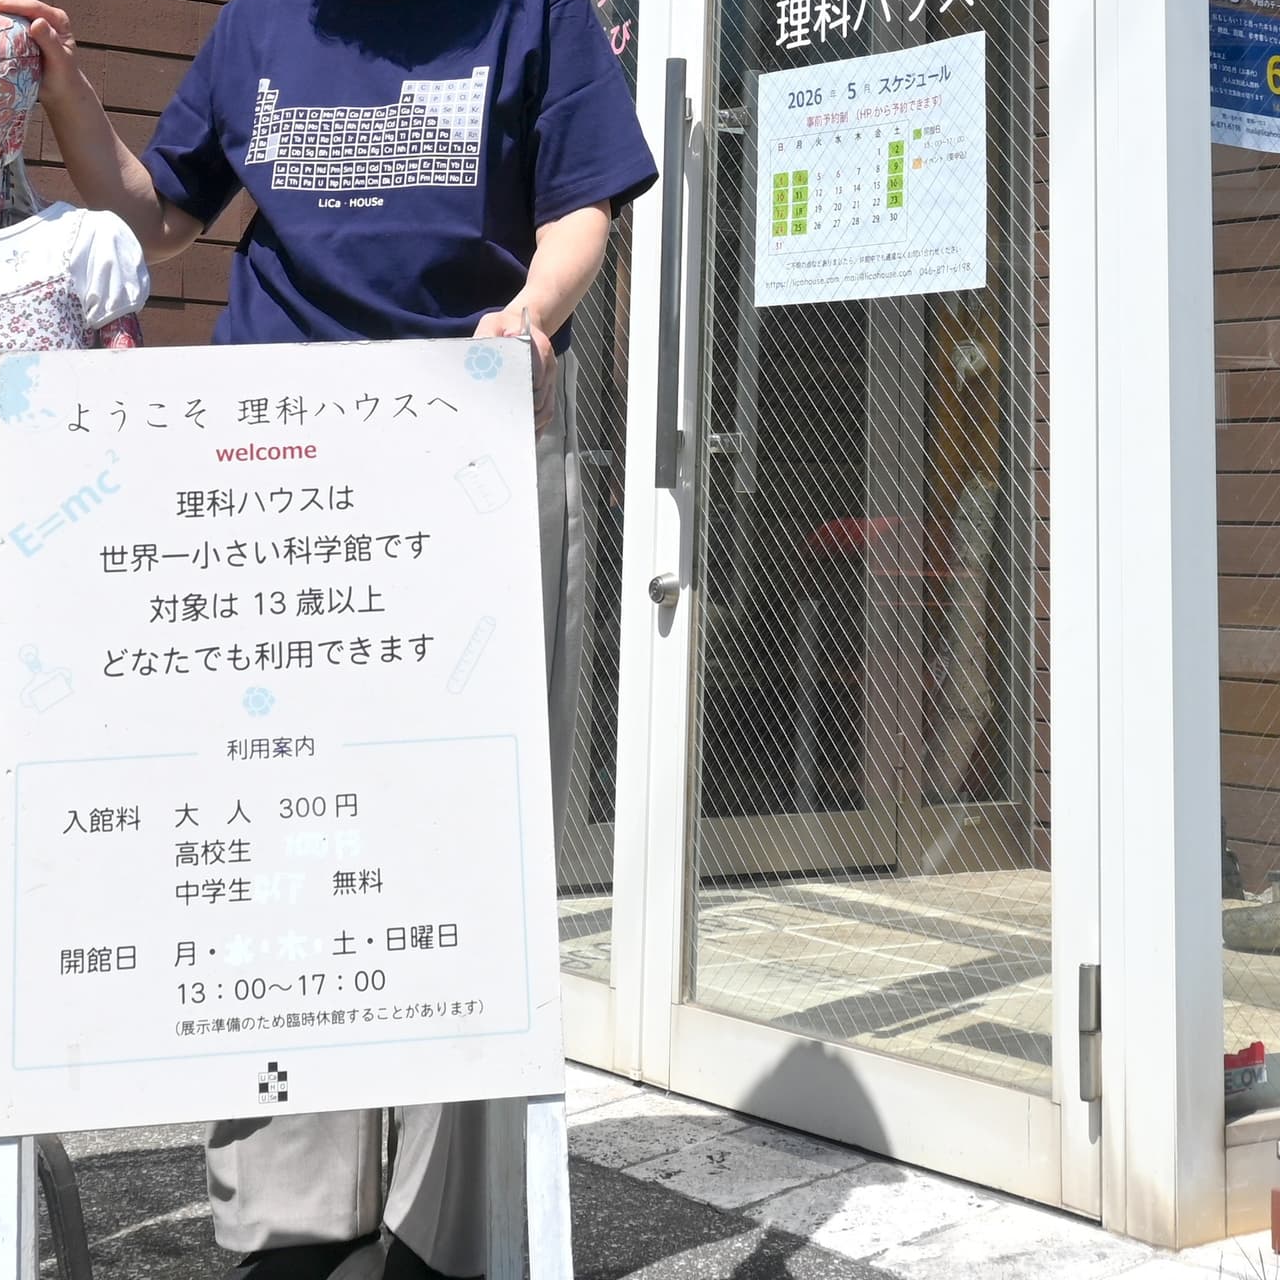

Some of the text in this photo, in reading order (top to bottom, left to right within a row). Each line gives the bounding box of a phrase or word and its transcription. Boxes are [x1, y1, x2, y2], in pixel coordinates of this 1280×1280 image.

[788, 88, 822, 109] 2026
[848, 83, 856, 99] 5
[879, 65, 951, 95] スケジュール
[66, 392, 458, 433] ようこそ 理科ハウスへ
[216, 441, 317, 463] welcome
[176, 485, 354, 518] 理科ハウスは
[100, 532, 431, 573] 世界一小さい科学館です
[103, 634, 435, 678] どなたでも利用できます
[227, 736, 315, 760] 利用案内
[63, 806, 140, 834] 入館料
[175, 839, 251, 866] 高校生
[176, 878, 252, 906] 中学生
[332, 869, 383, 896] 無料
[60, 946, 137, 976] 開館日
